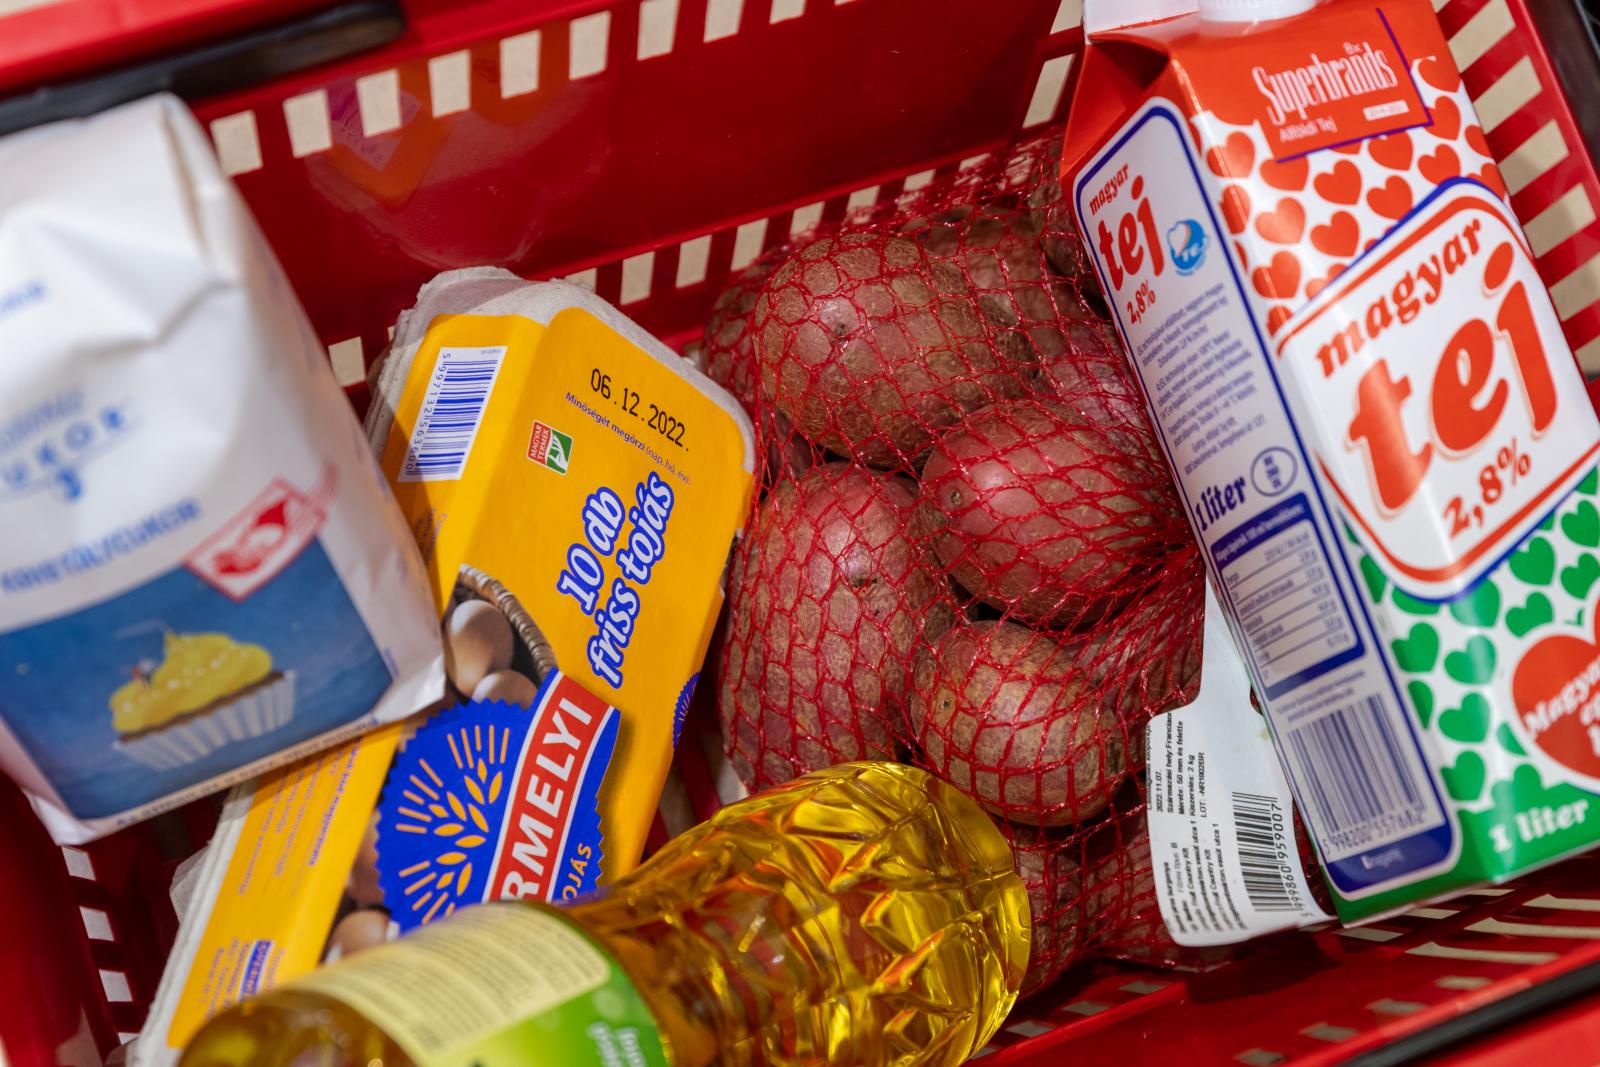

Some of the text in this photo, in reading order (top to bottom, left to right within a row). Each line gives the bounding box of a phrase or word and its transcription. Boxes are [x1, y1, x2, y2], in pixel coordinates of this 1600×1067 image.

[1252, 42, 1398, 126] Superbrands
[1089, 163, 1130, 214] magyar
[1098, 175, 1165, 291] tej
[1127, 280, 1157, 325] 2,8%
[1314, 217, 1483, 379] magyar
[424, 366, 447, 413] 997132
[1346, 241, 1559, 512] tej
[565, 392, 611, 428] Minőségét
[611, 423, 646, 452] megőrzi
[590, 368, 689, 452] 06.12.2022.
[405, 421, 428, 471] 563600
[530, 424, 542, 457] MAGYAR
[537, 429, 549, 460] TERMÉK
[1196, 476, 1246, 531] 1 liter
[1443, 438, 1531, 541] 2,8%
[558, 487, 624, 614] 10 db
[588, 472, 674, 689] friss tojás
[1188, 755, 1195, 765] kg
[1182, 848, 1190, 859] Kft
[1271, 803, 1289, 860] 959007
[1489, 798, 1589, 854] 1 liter
[1185, 860, 1194, 890] Country
[1207, 861, 1217, 890] Country
